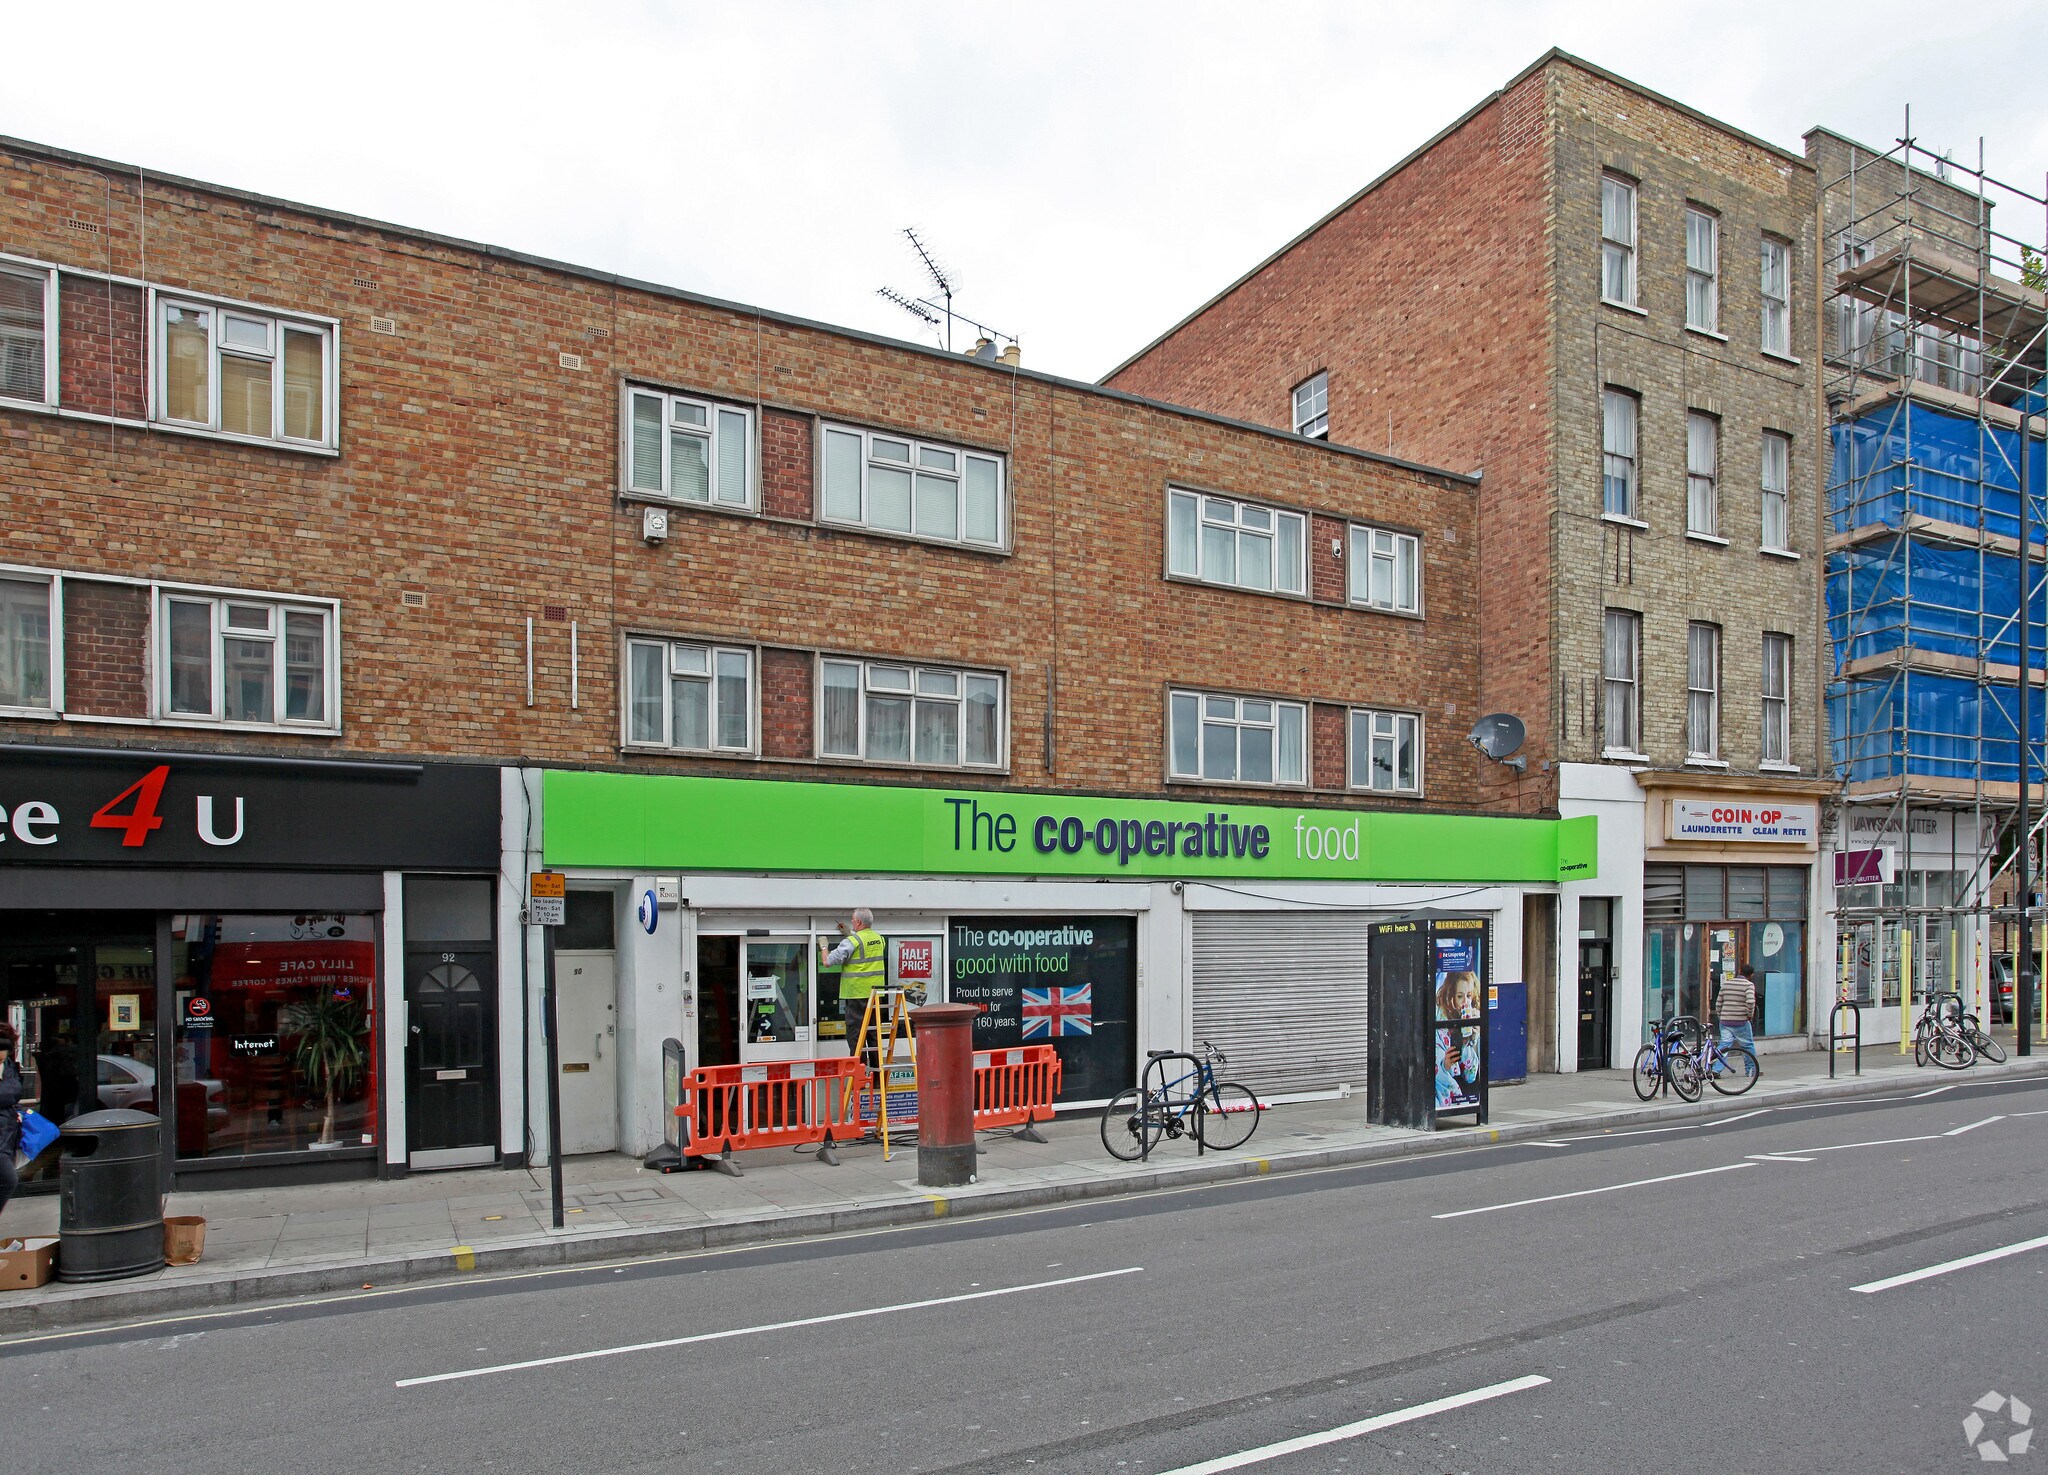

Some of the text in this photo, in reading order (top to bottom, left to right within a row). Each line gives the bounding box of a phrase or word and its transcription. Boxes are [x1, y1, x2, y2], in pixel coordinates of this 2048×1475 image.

[0, 765, 244, 847] e 4 U
[944, 798, 1359, 866] The co-operative food
[1681, 825, 1807, 836] LAUNDERETTE CLEAN RETTE
[1394, 924, 1409, 933] here
[1440, 921, 1479, 929] TELEPHONE
[954, 925, 1094, 950] The co-operative
[442, 952, 455, 962] 92
[901, 948, 929, 960] HALF
[901, 960, 929, 971] PRICE
[956, 952, 1069, 979] good with food
[956, 987, 1014, 997] Proud to serve
[30, 999, 59, 1008] OPEN
[990, 1001, 1002, 1012] for
[976, 1017, 1018, 1029] 160 years.
[234, 1039, 275, 1049] Internet
